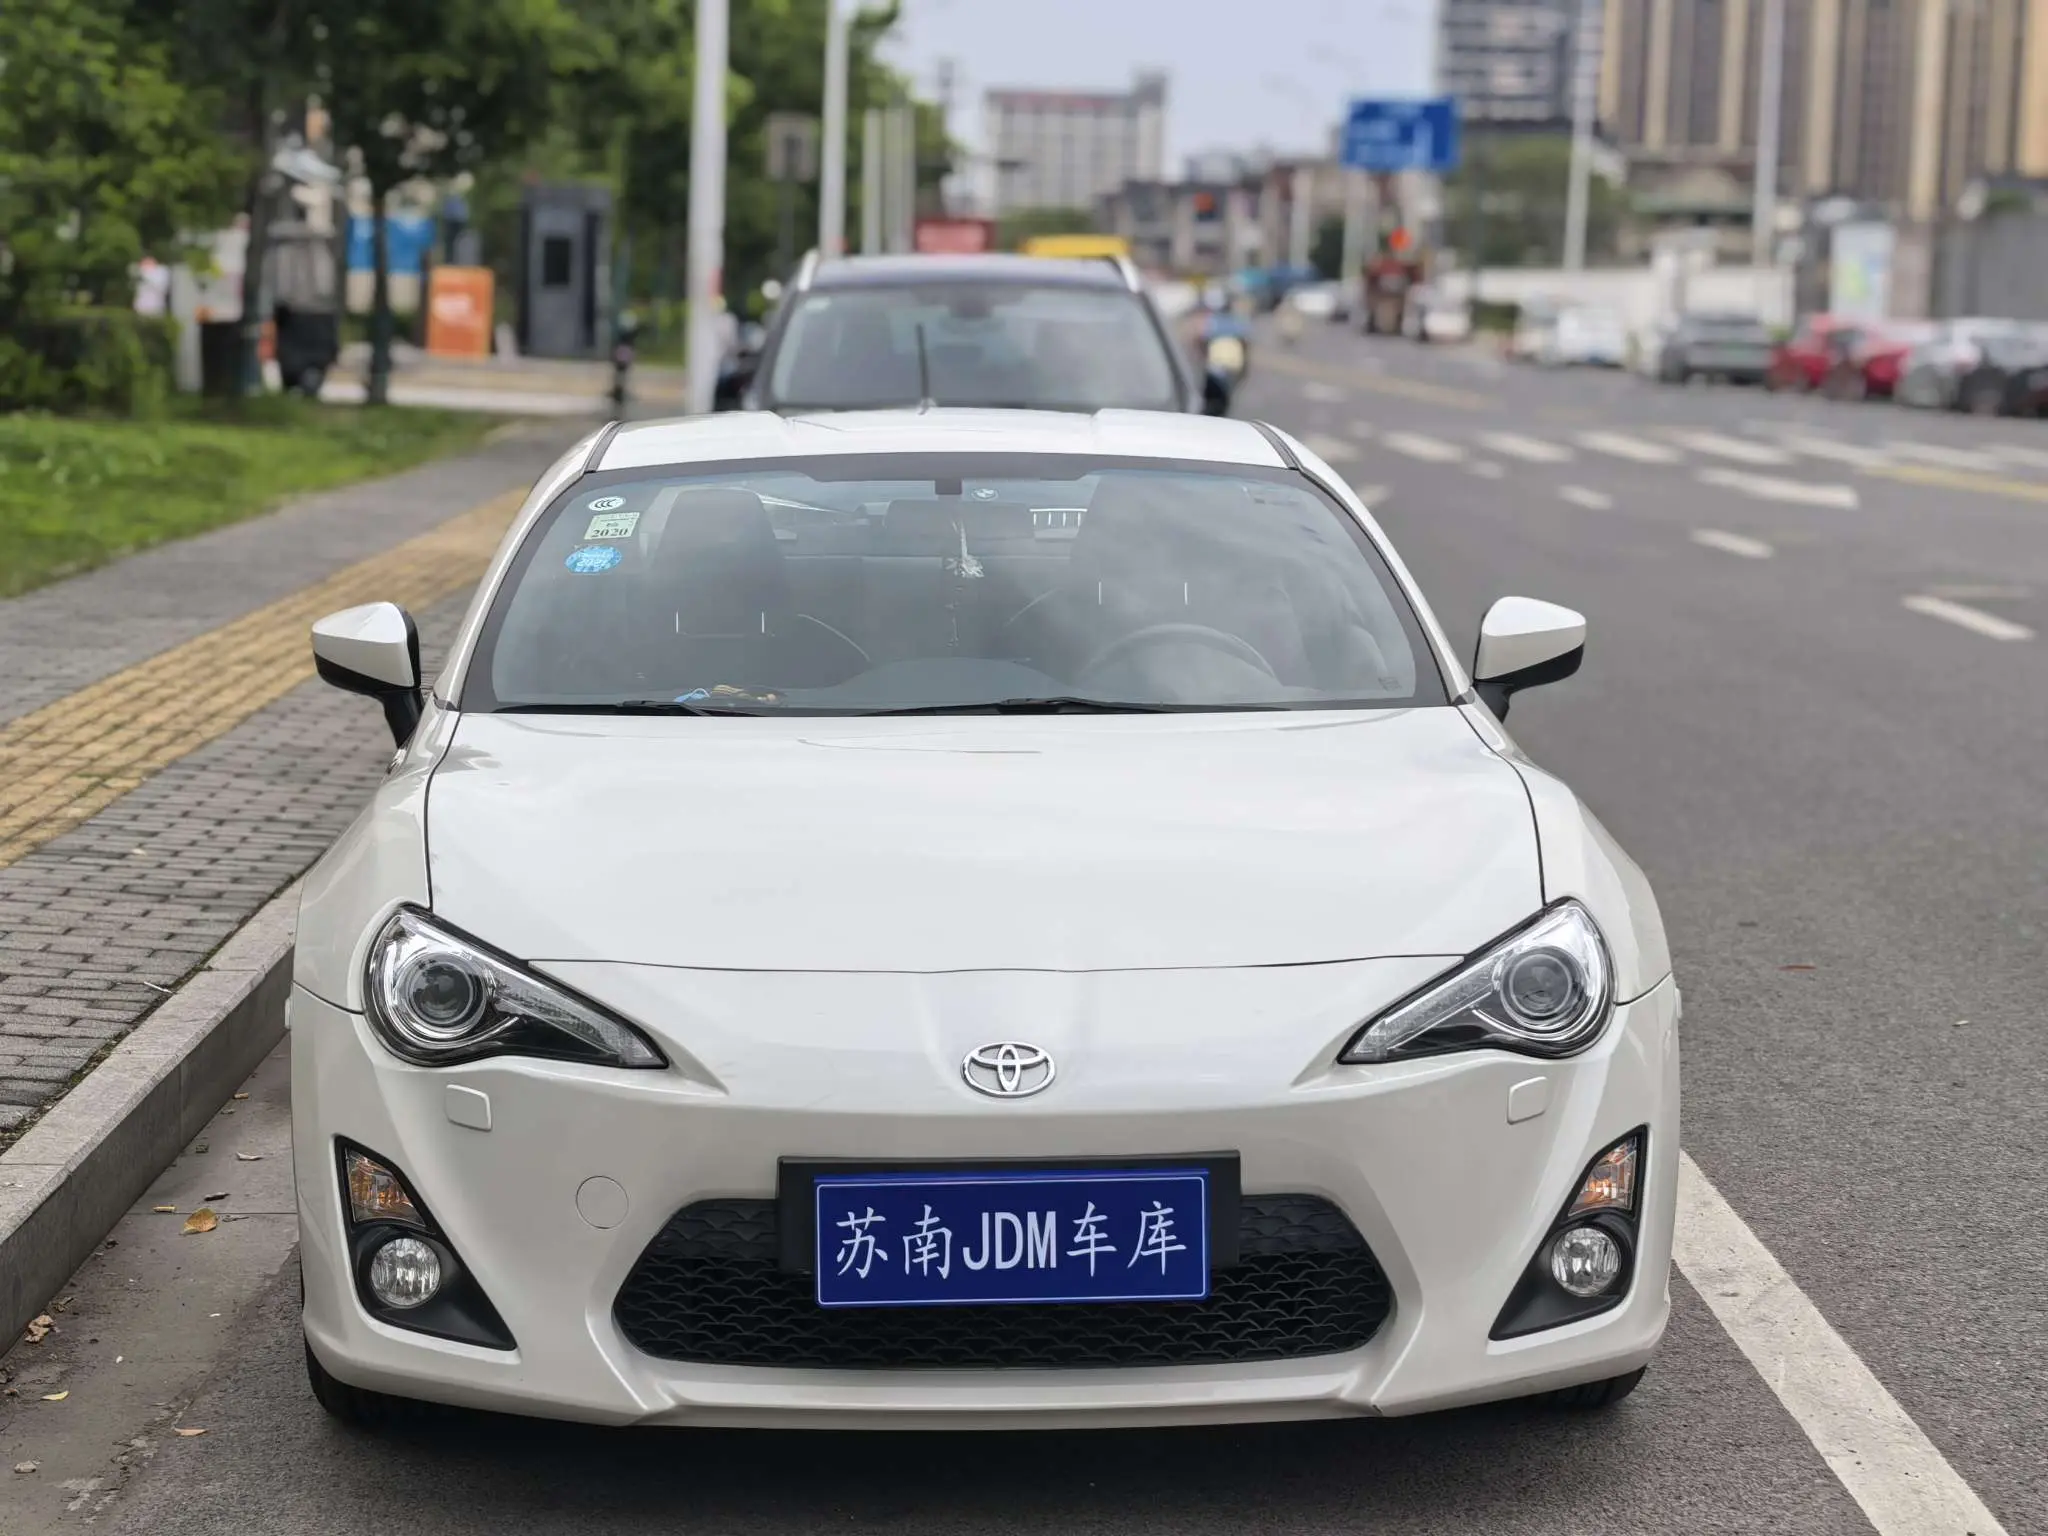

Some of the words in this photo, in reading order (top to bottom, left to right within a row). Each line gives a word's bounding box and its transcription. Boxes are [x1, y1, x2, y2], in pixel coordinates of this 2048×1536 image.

[591, 528, 628, 537] 2020
[836, 1201, 1187, 1279] 苏南JDM车库
